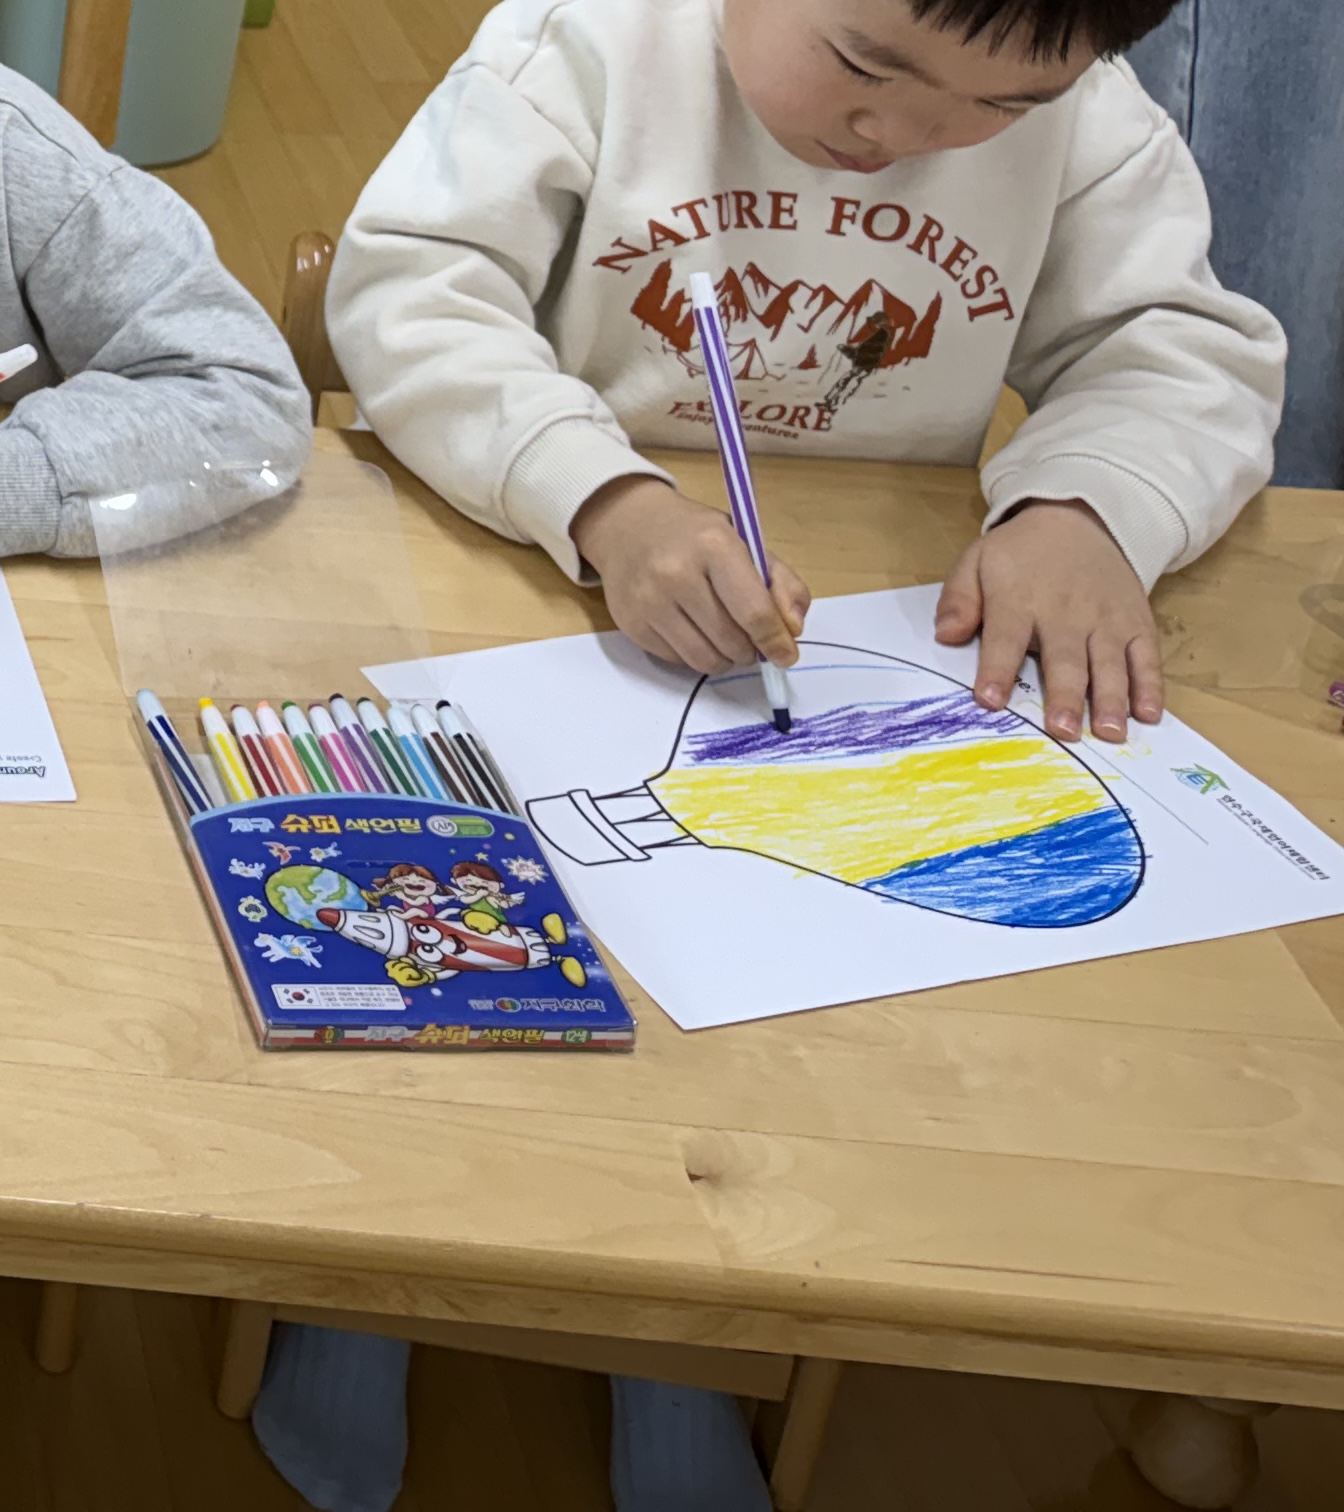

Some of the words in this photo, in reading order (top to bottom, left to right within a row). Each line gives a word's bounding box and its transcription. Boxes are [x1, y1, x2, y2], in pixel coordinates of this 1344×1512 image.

[592, 190, 799, 274] NATURE
[825, 196, 1015, 323] FOREST
[6, 754, 42, 762] Create
